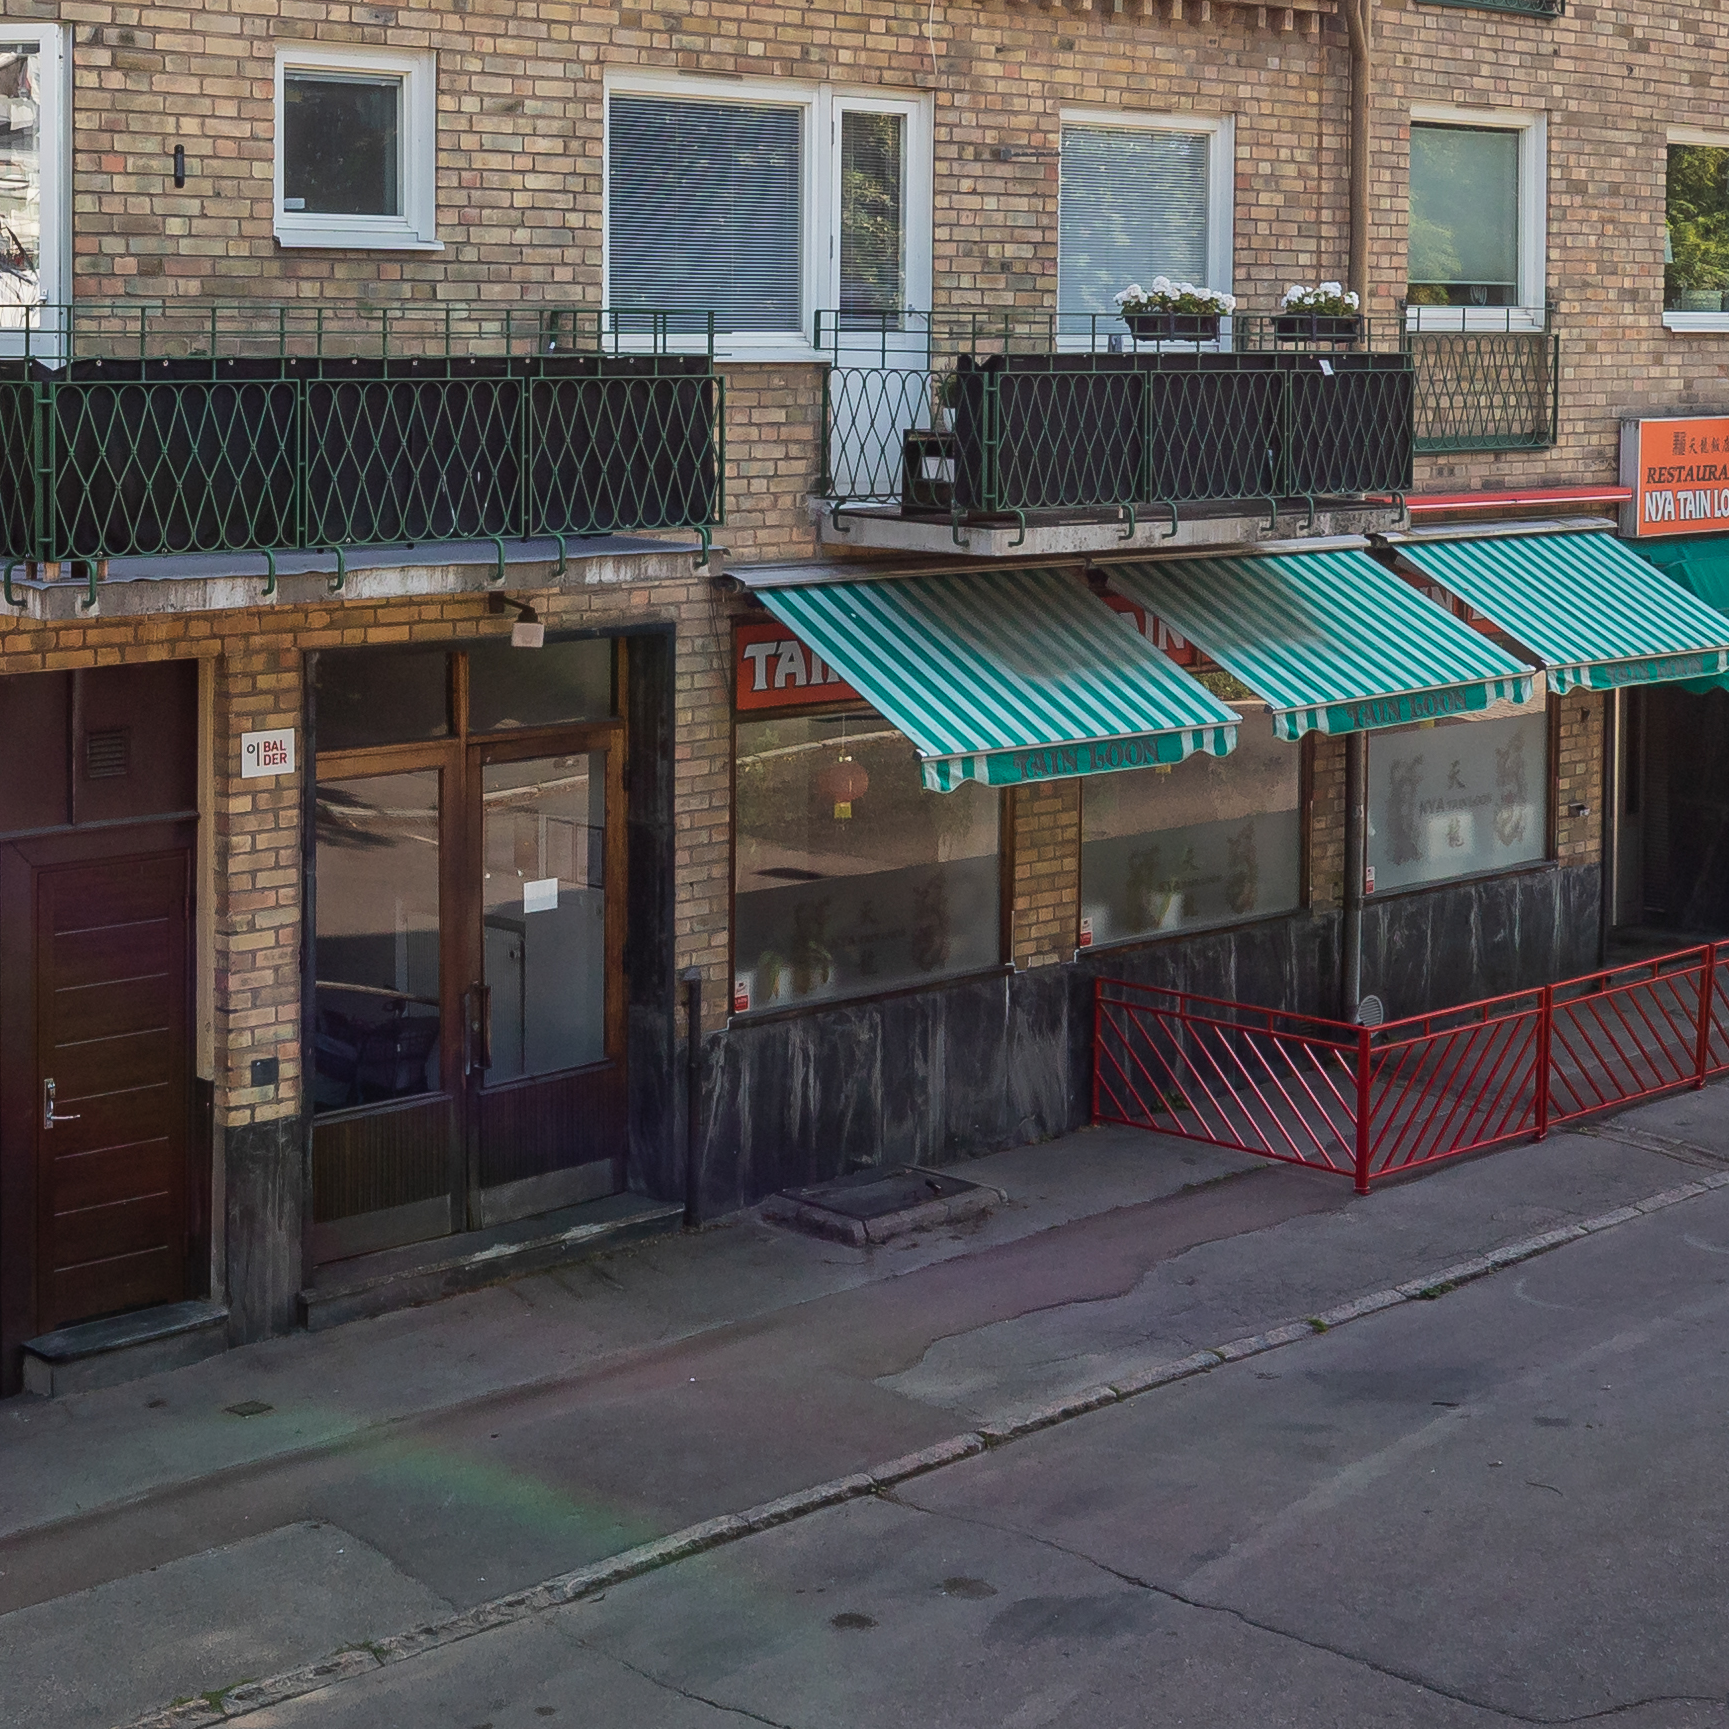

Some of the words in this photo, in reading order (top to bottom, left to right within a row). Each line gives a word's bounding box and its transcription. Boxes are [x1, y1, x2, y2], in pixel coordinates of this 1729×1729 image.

[1644, 490, 1676, 522] NYA
[1676, 489, 1711, 520] TAIN
[743, 640, 841, 691] TAI
[1346, 696, 1402, 728] TAIN
[1409, 688, 1467, 718] LOON
[263, 740, 287, 753] BAL
[263, 752, 288, 766] DER
[1013, 745, 1079, 779] TAIN
[1089, 737, 1160, 770] LOON
